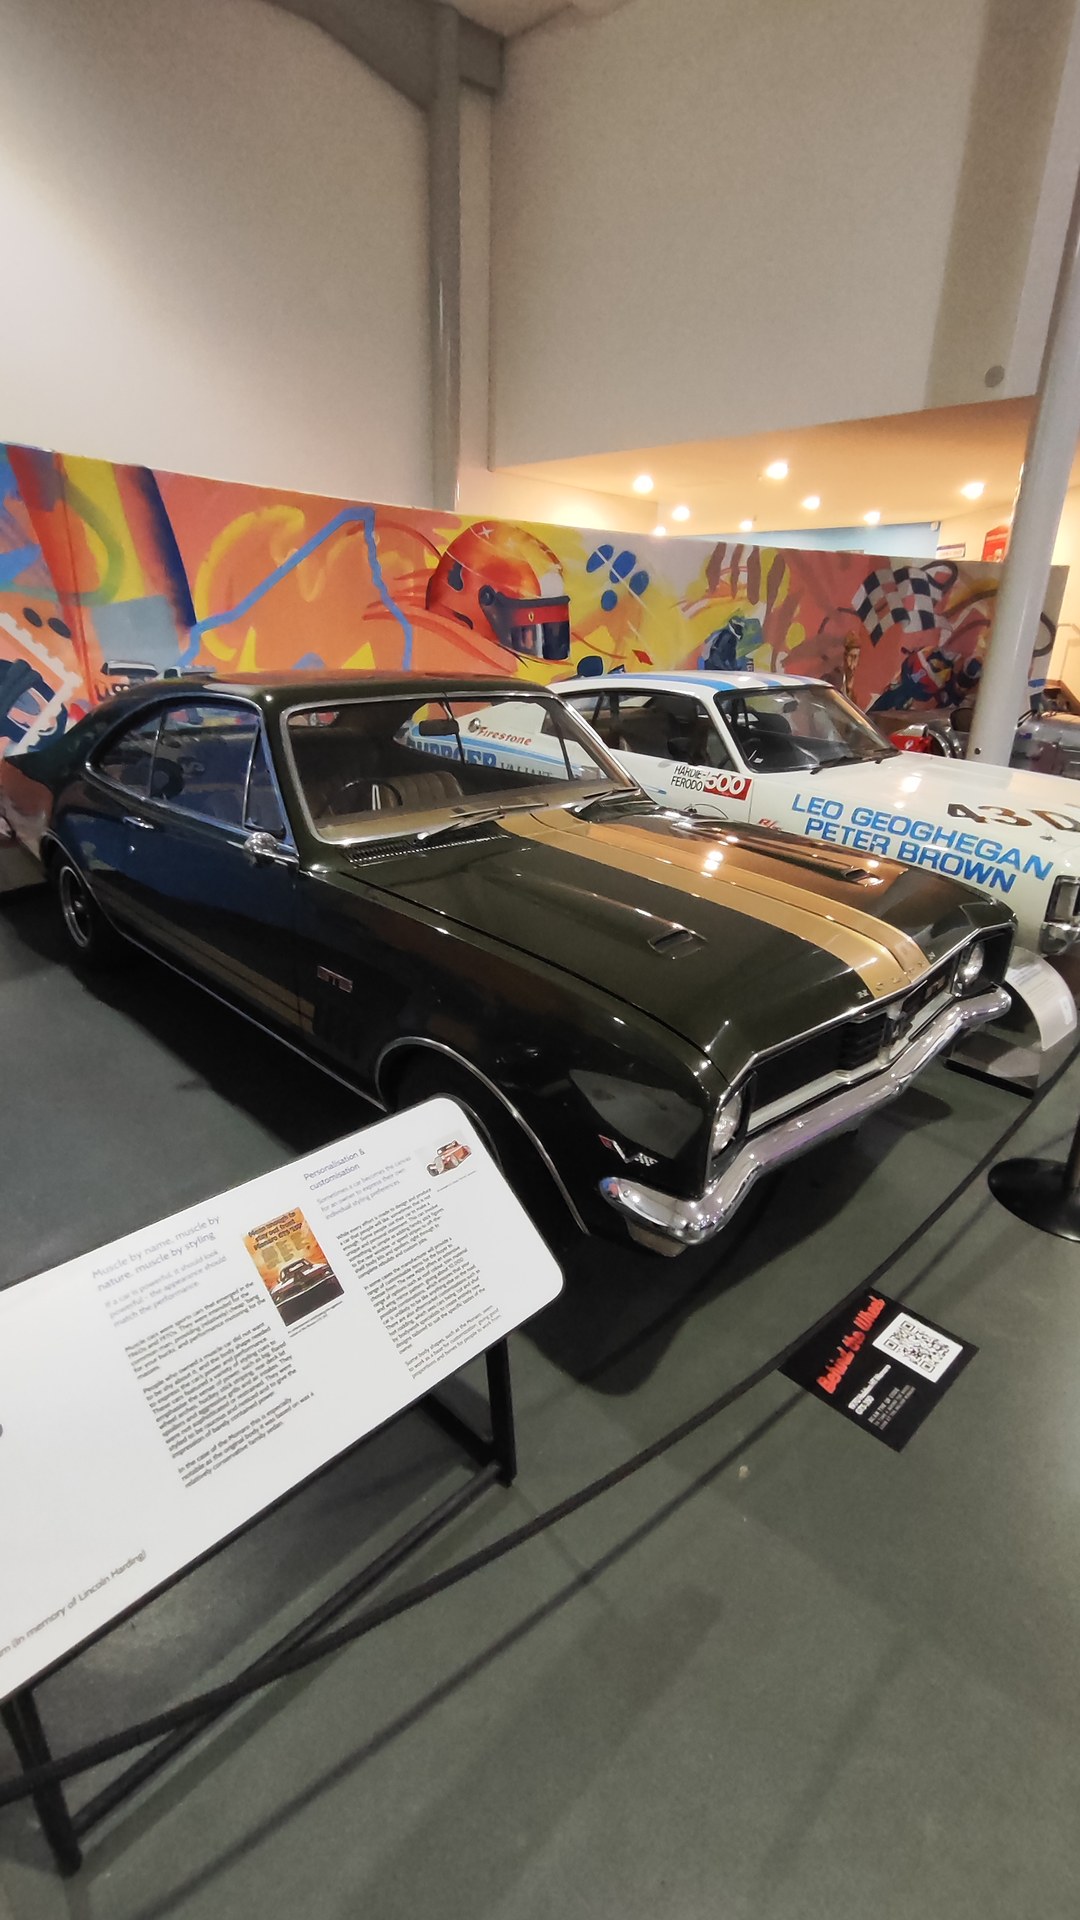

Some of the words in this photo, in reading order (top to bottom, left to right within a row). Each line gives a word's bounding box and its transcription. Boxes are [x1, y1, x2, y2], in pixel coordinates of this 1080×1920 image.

[477, 726, 532, 746] Firestone
[671, 776, 703, 791] FERODO
[704, 773, 746, 795] 500
[792, 794, 844, 820] LEO
[851, 807, 1054, 881] GEOGHEGAN
[805, 818, 891, 855] PETER
[897, 840, 1017, 893] BROWN
[304, 1153, 359, 1181] Personalisation
[359, 1148, 365, 1156] &
[310, 1164, 360, 1191] customisation
[816, 1346, 855, 1394] Behind
[26, 1608, 66, 1639] memory
[67, 1597, 78, 1610] of
[78, 1575, 110, 1602] Lincoln
[110, 1549, 147, 1578] Harding)
